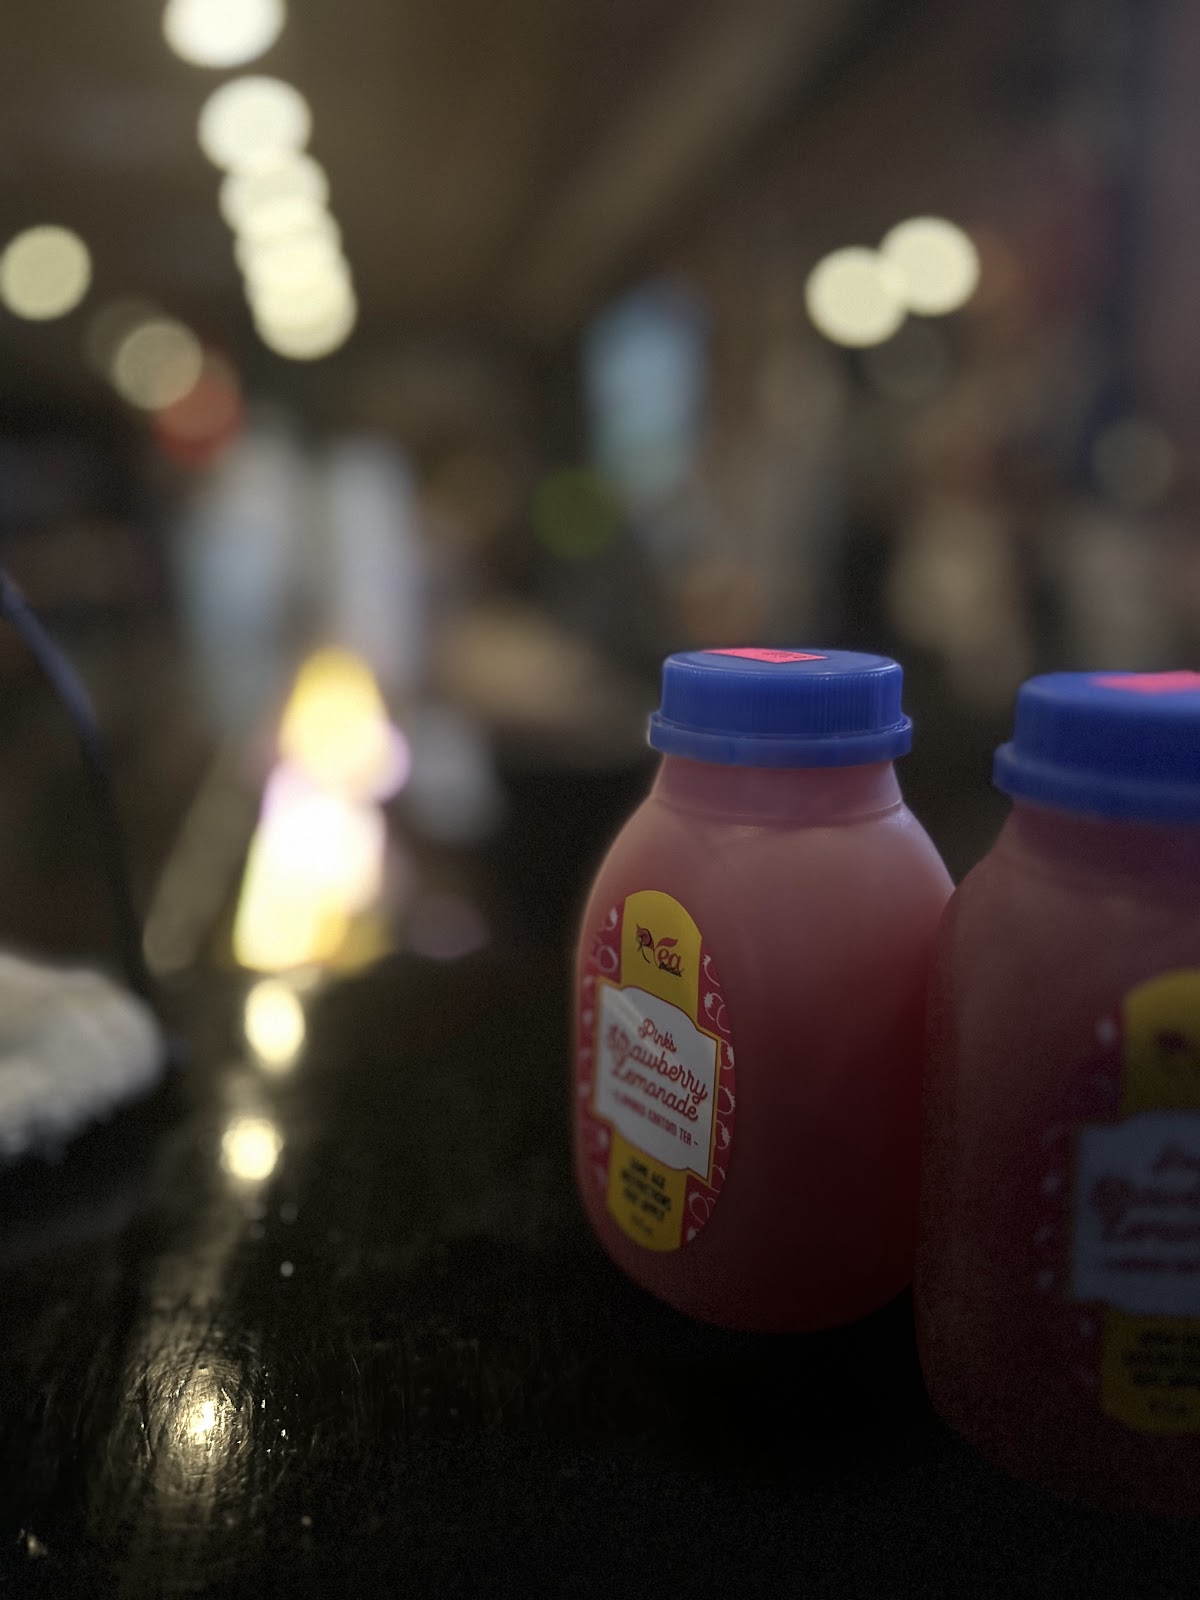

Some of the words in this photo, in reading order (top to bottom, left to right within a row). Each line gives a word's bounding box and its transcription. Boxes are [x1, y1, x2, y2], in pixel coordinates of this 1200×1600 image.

[638, 1017, 677, 1053] Pink's
[608, 1056, 698, 1122] Lemonade
[680, 1127, 692, 1146] TEA
